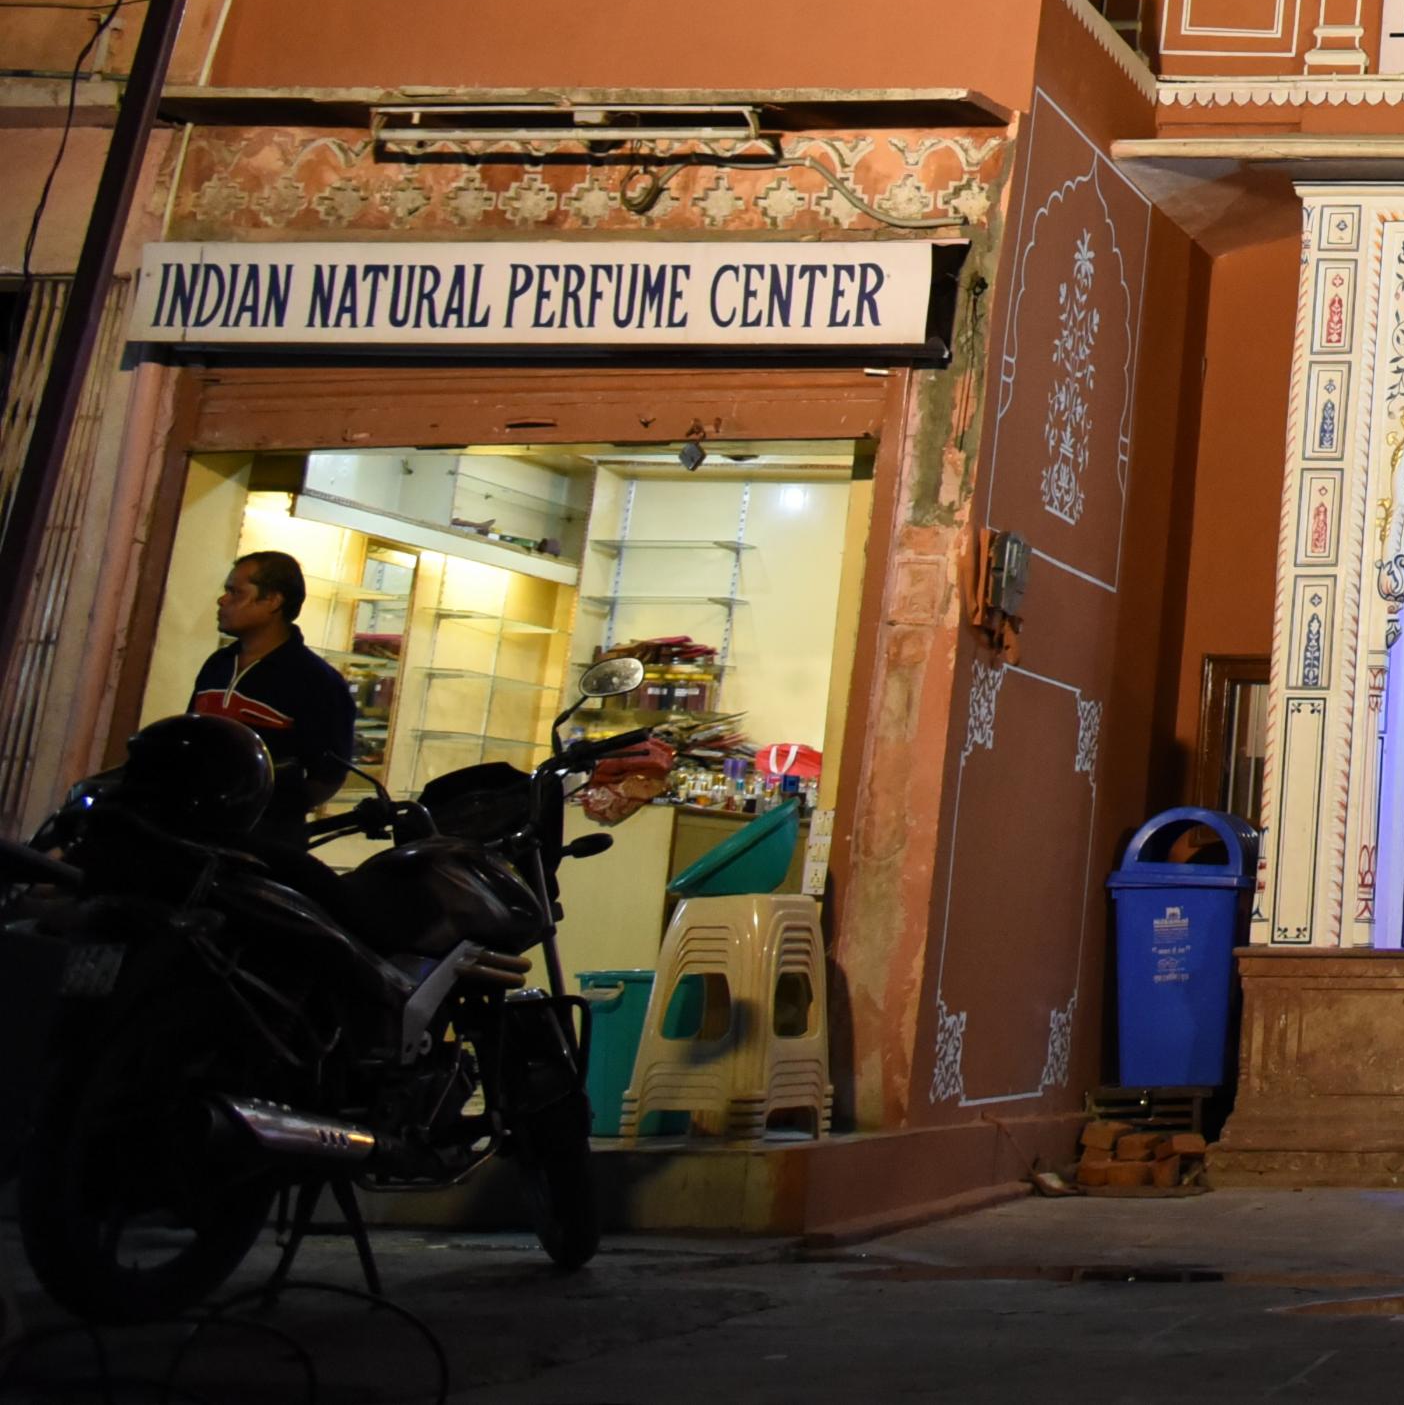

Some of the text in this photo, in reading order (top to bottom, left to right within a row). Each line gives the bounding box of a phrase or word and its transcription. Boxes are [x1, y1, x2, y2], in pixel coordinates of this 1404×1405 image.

[152, 262, 885, 329] INDIAN NATURAL PERFUME CENTER
